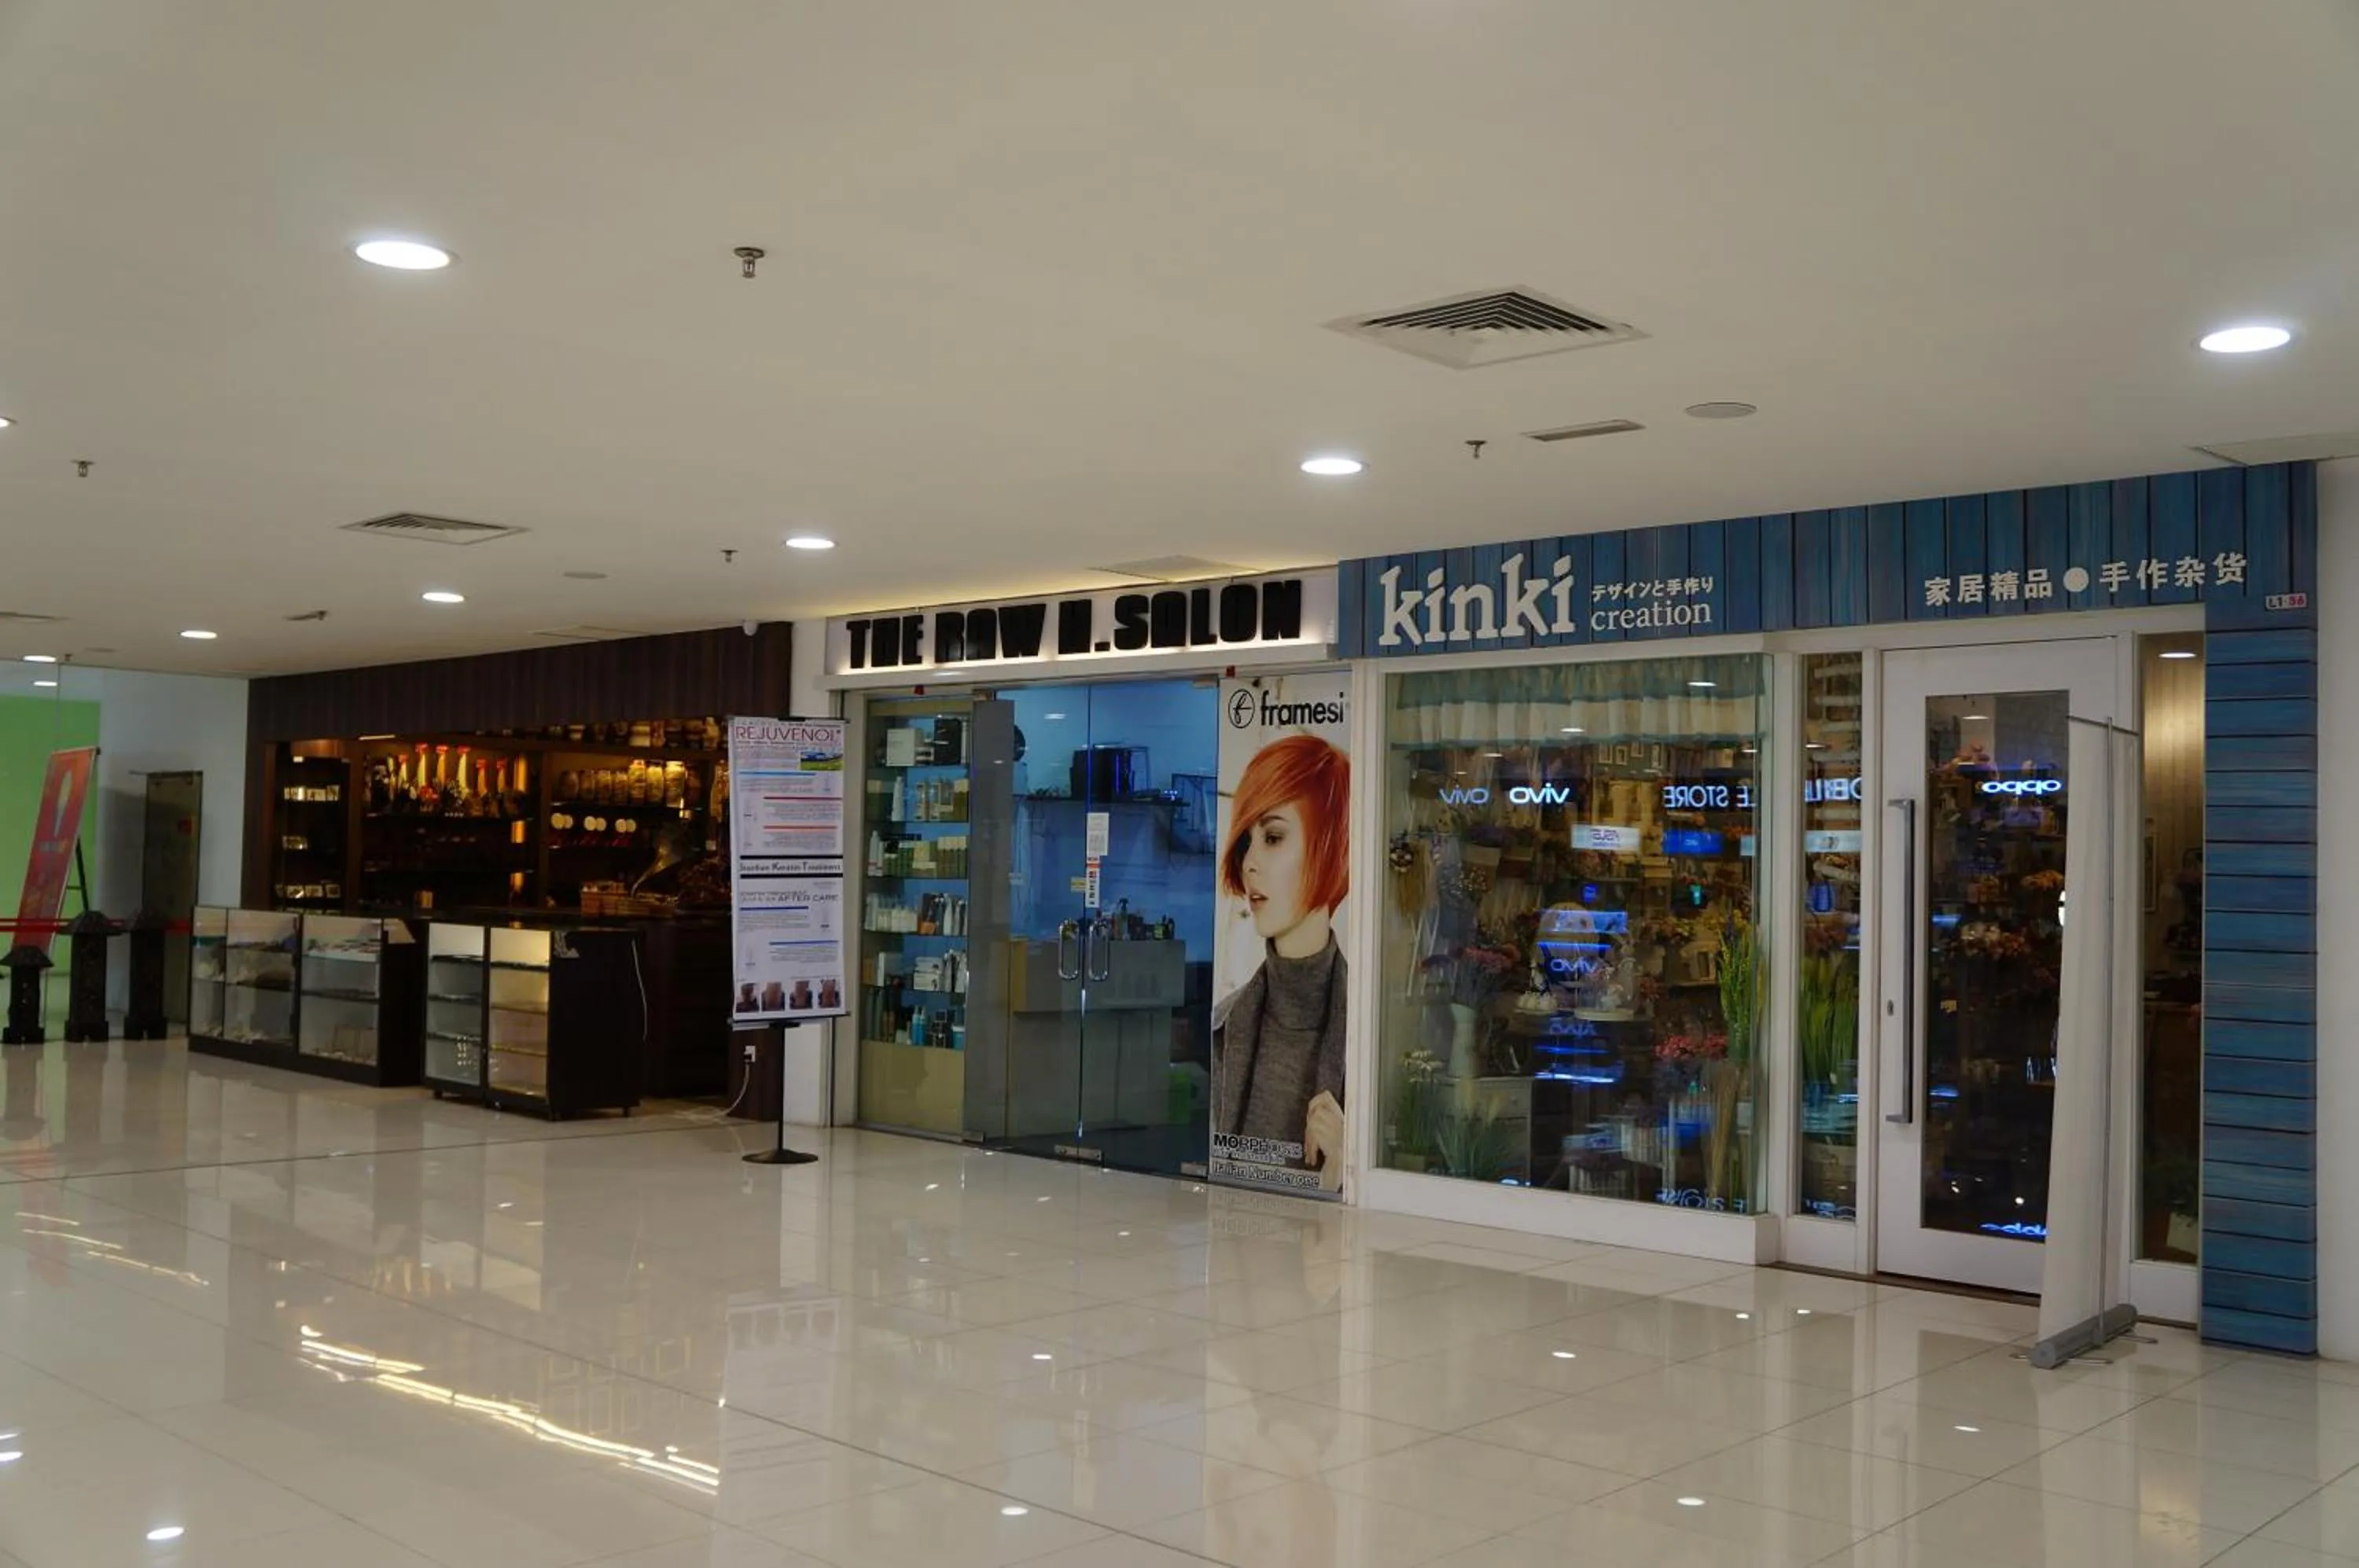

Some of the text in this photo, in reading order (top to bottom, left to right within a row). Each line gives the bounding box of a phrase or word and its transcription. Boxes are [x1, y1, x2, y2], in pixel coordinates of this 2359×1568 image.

[1378, 552, 1576, 646] kinki
[1924, 551, 2247, 607] 家居精品 手作杂货
[846, 614, 924, 669] THE
[1591, 600, 1712, 631] creation
[1260, 689, 1345, 727] framesi
